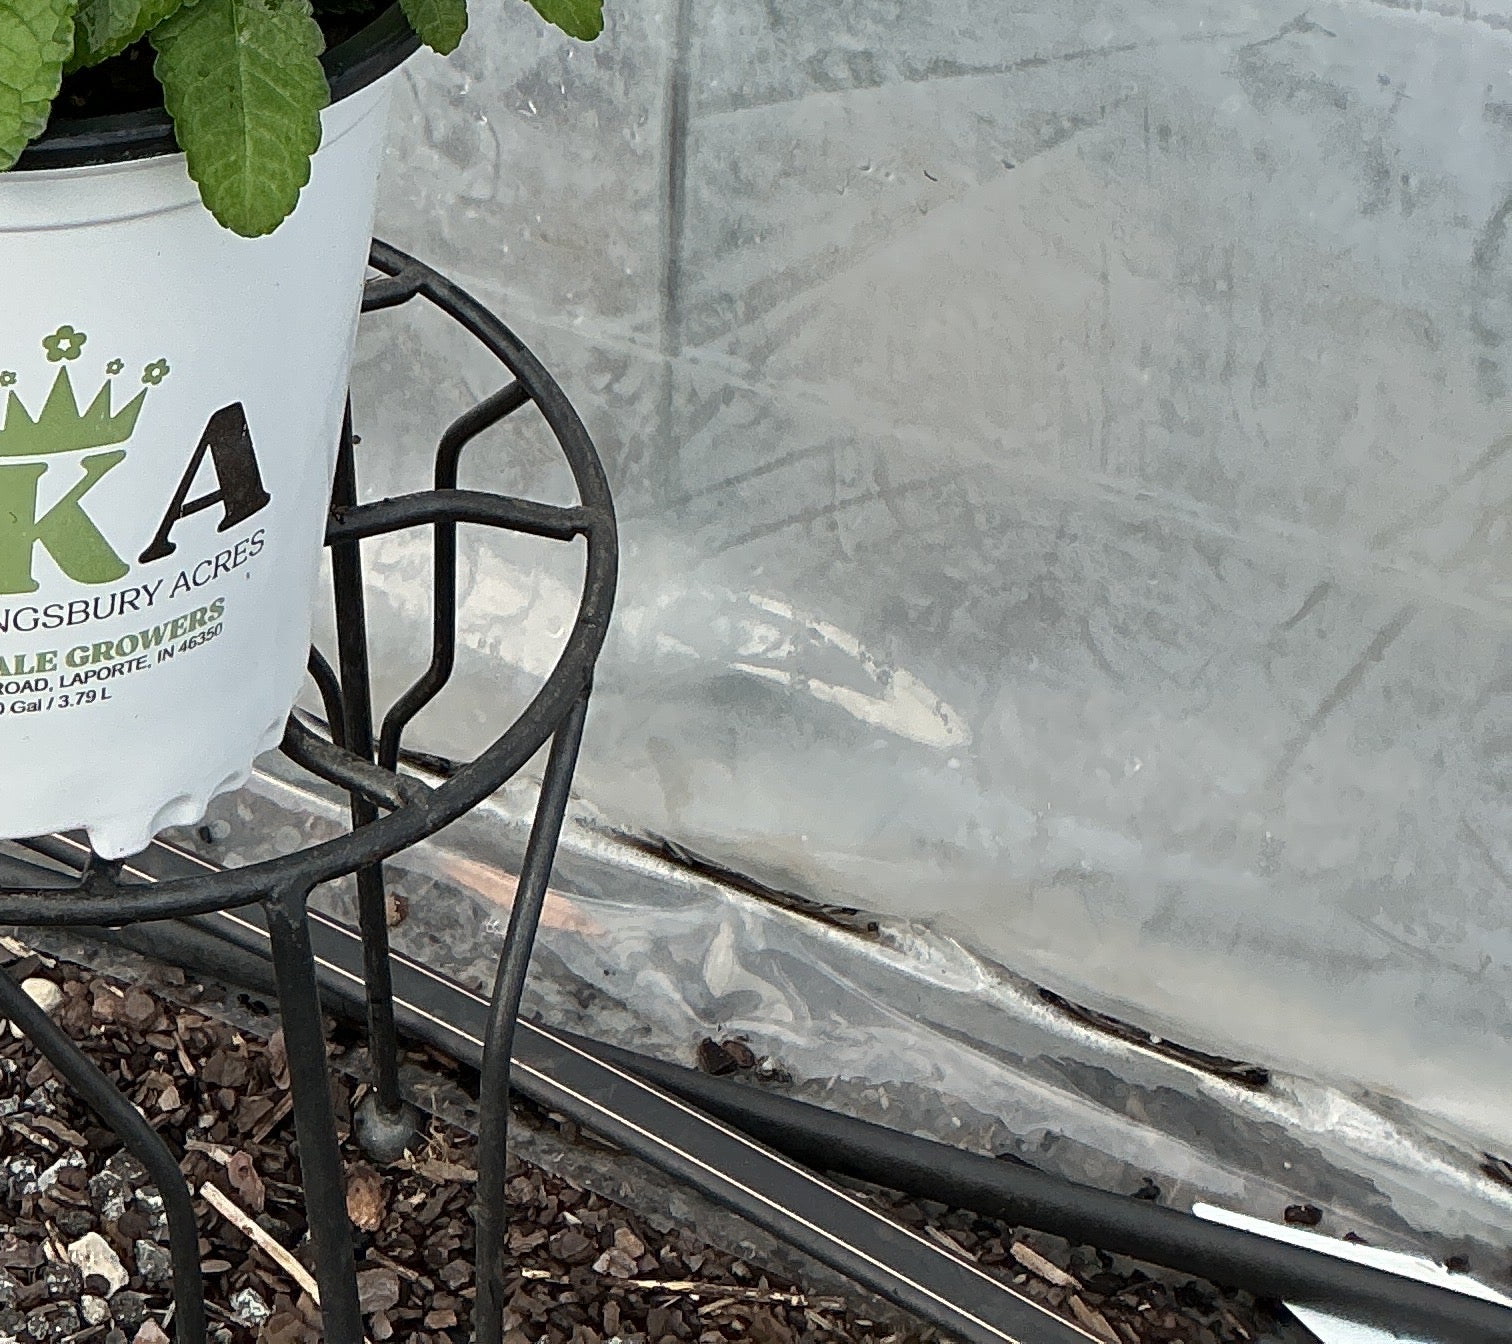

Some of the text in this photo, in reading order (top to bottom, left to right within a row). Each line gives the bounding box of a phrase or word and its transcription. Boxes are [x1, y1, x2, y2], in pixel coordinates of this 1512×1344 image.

[169, 528, 266, 599] ACRES
[59, 657, 153, 690] LAPORTE,
[156, 647, 176, 667] IN
[178, 622, 224, 656] 46350
[64, 596, 226, 669] GROWERS
[10, 697, 43, 716] Gal
[58, 690, 97, 710] 3.79
[100, 687, 112, 702] L
